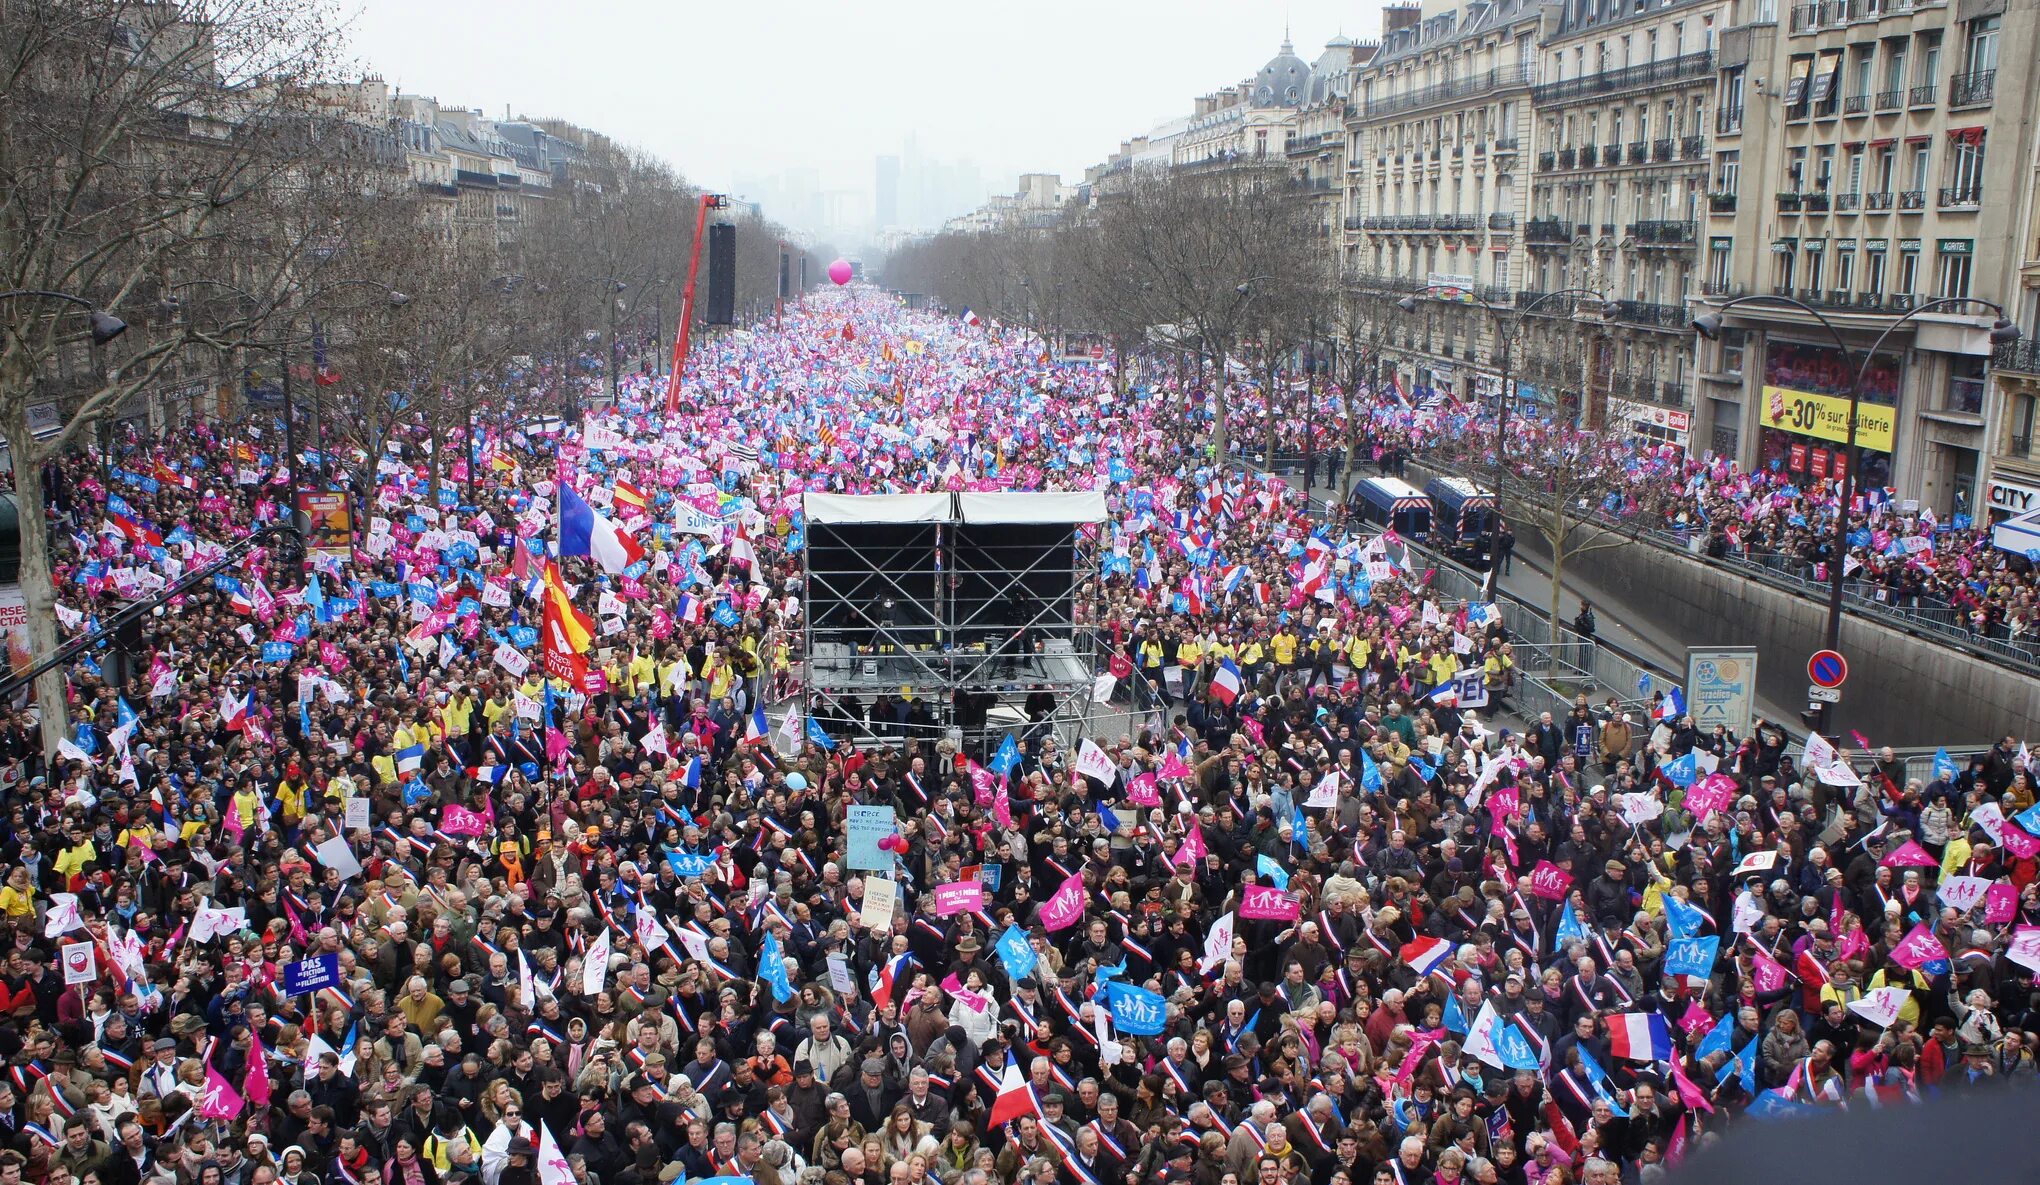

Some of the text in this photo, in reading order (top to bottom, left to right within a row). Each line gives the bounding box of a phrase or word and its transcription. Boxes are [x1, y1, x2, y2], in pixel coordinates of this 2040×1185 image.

[1804, 241, 1822, 250] AGRITEL
[1837, 240, 1856, 249] AGRITEL
[1866, 240, 1887, 249] AGRITEL
[1900, 240, 1921, 249] AGRITEL
[1943, 241, 1966, 251] AGRITEL
[1785, 399, 1826, 430] -30%
[1827, 411, 1845, 424] sur
[1857, 412, 1889, 433] literie
[1992, 485, 2033, 509] CITY
[687, 516, 708, 529] SUR
[963, 888, 979, 896] MÈRE
[301, 957, 322, 971] PAS
[303, 967, 326, 977] FICTION
[301, 975, 330, 987] FILIATION
